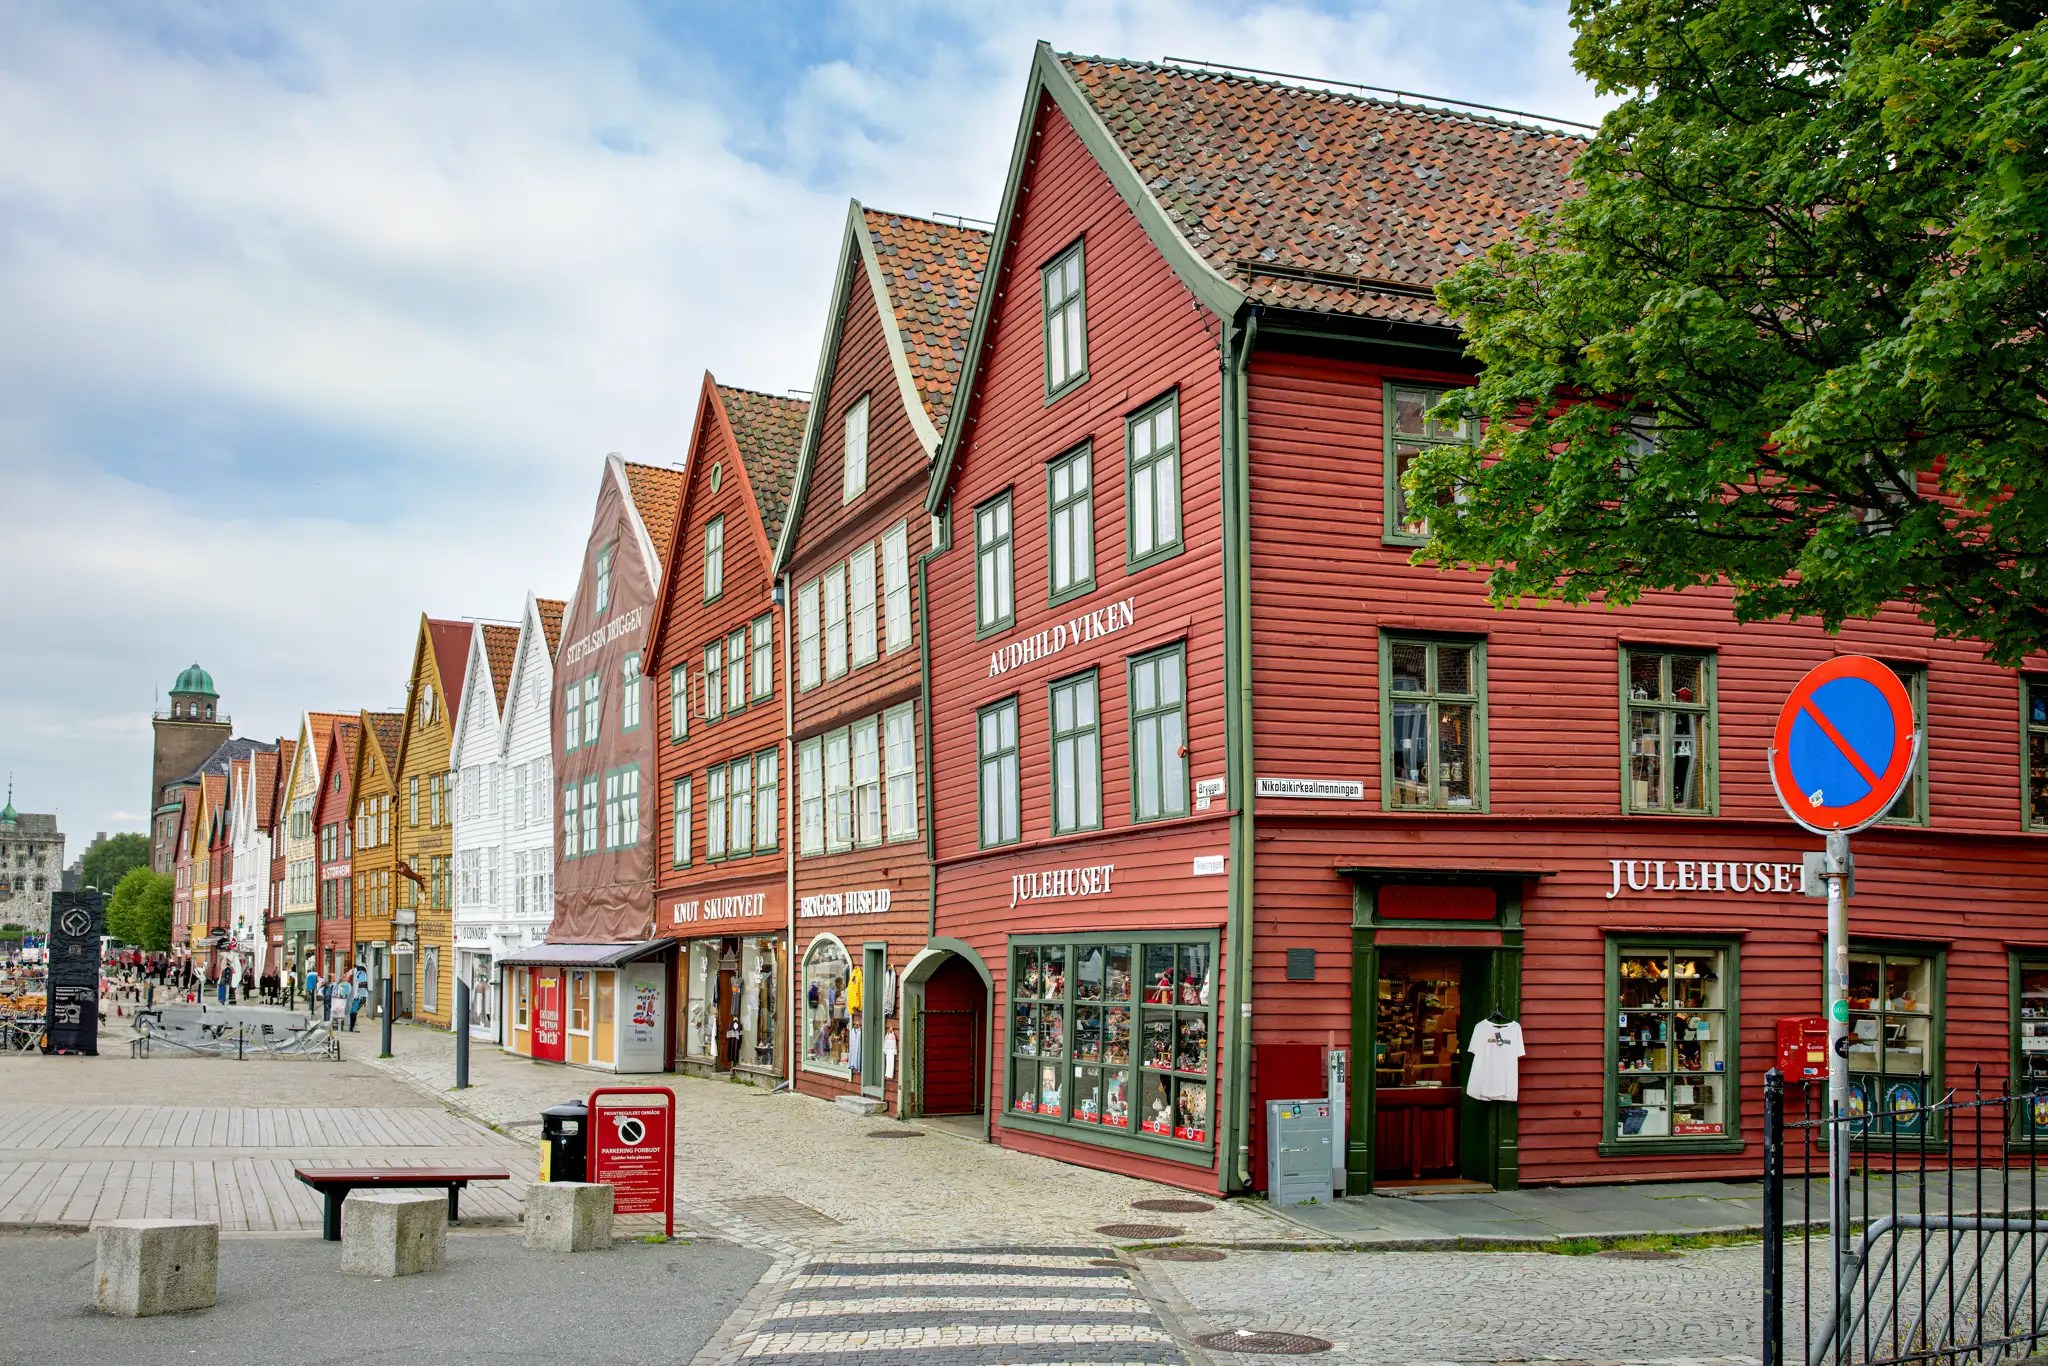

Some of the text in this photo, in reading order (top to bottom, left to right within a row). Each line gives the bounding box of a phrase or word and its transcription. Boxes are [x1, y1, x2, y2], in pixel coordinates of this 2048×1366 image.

[988, 597, 1136, 678] AUDHILD VIKEN
[1198, 783, 1220, 796] Bryggen
[1261, 780, 1359, 797] Nikolaikirkeallmenningen
[1009, 864, 1115, 909] JULEHUSET
[673, 893, 766, 924] KNUT SKURTVEIT
[800, 888, 892, 918] BRYGGEN HUSFLID
